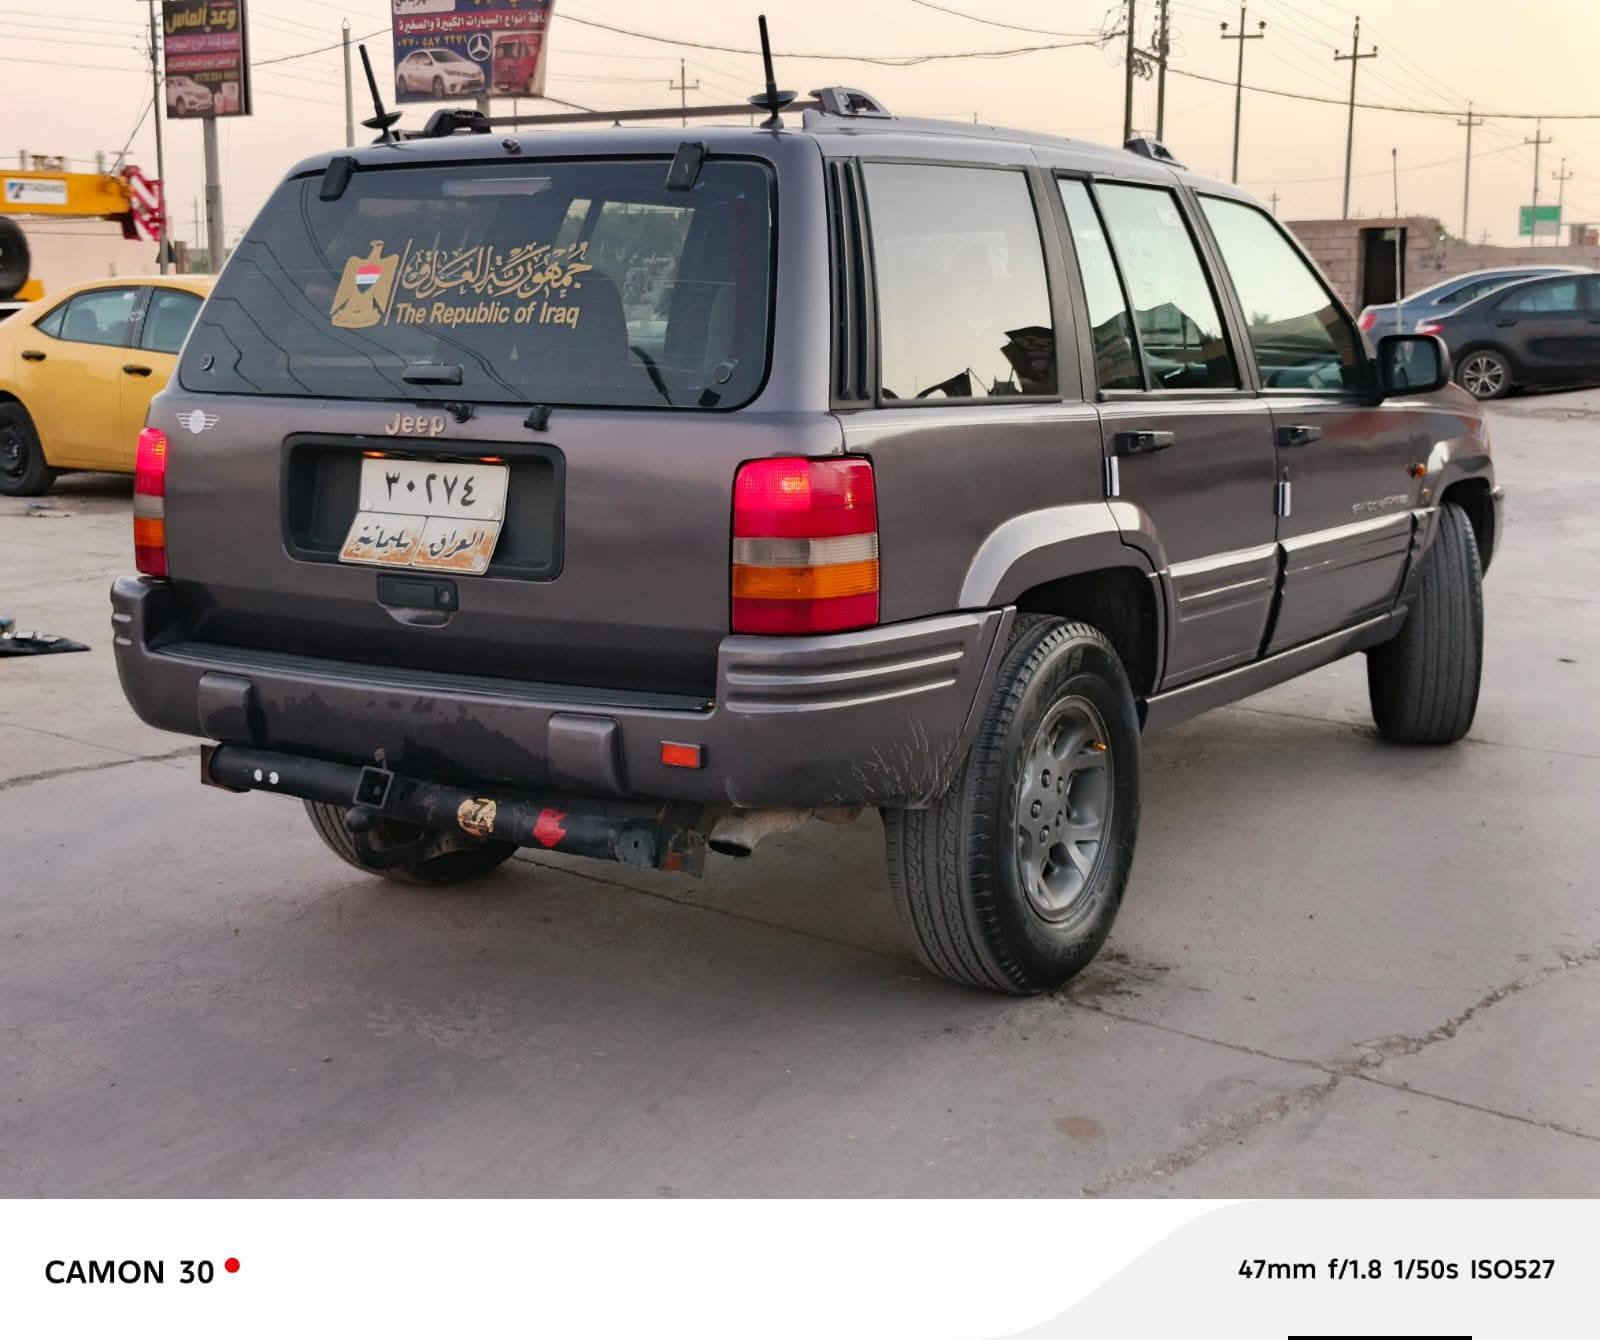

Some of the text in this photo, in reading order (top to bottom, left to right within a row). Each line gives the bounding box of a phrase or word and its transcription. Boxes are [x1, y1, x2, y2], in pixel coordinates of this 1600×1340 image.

[396, 302, 580, 329] The Republic of Iraq
[429, 529, 487, 558] العراق
